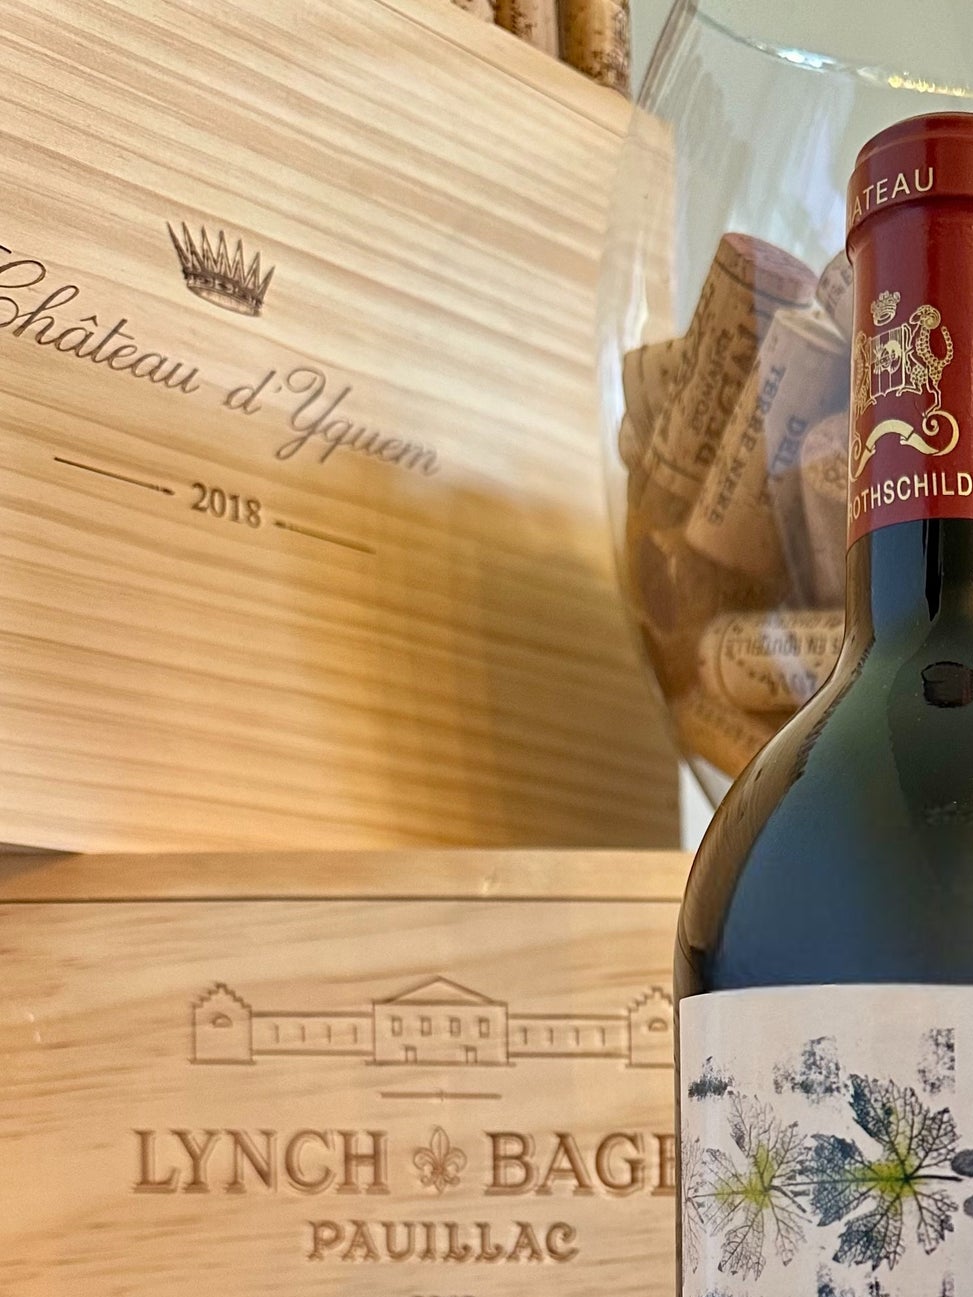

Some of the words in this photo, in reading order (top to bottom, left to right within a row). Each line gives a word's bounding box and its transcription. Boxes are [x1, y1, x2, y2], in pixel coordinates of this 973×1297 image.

[0, 244, 199, 393] Château
[221, 367, 441, 477] d'Yquem
[192, 482, 262, 529] 2018
[133, 1128, 390, 1195] LYNCH
[307, 1219, 579, 1263] PAUILLAC
